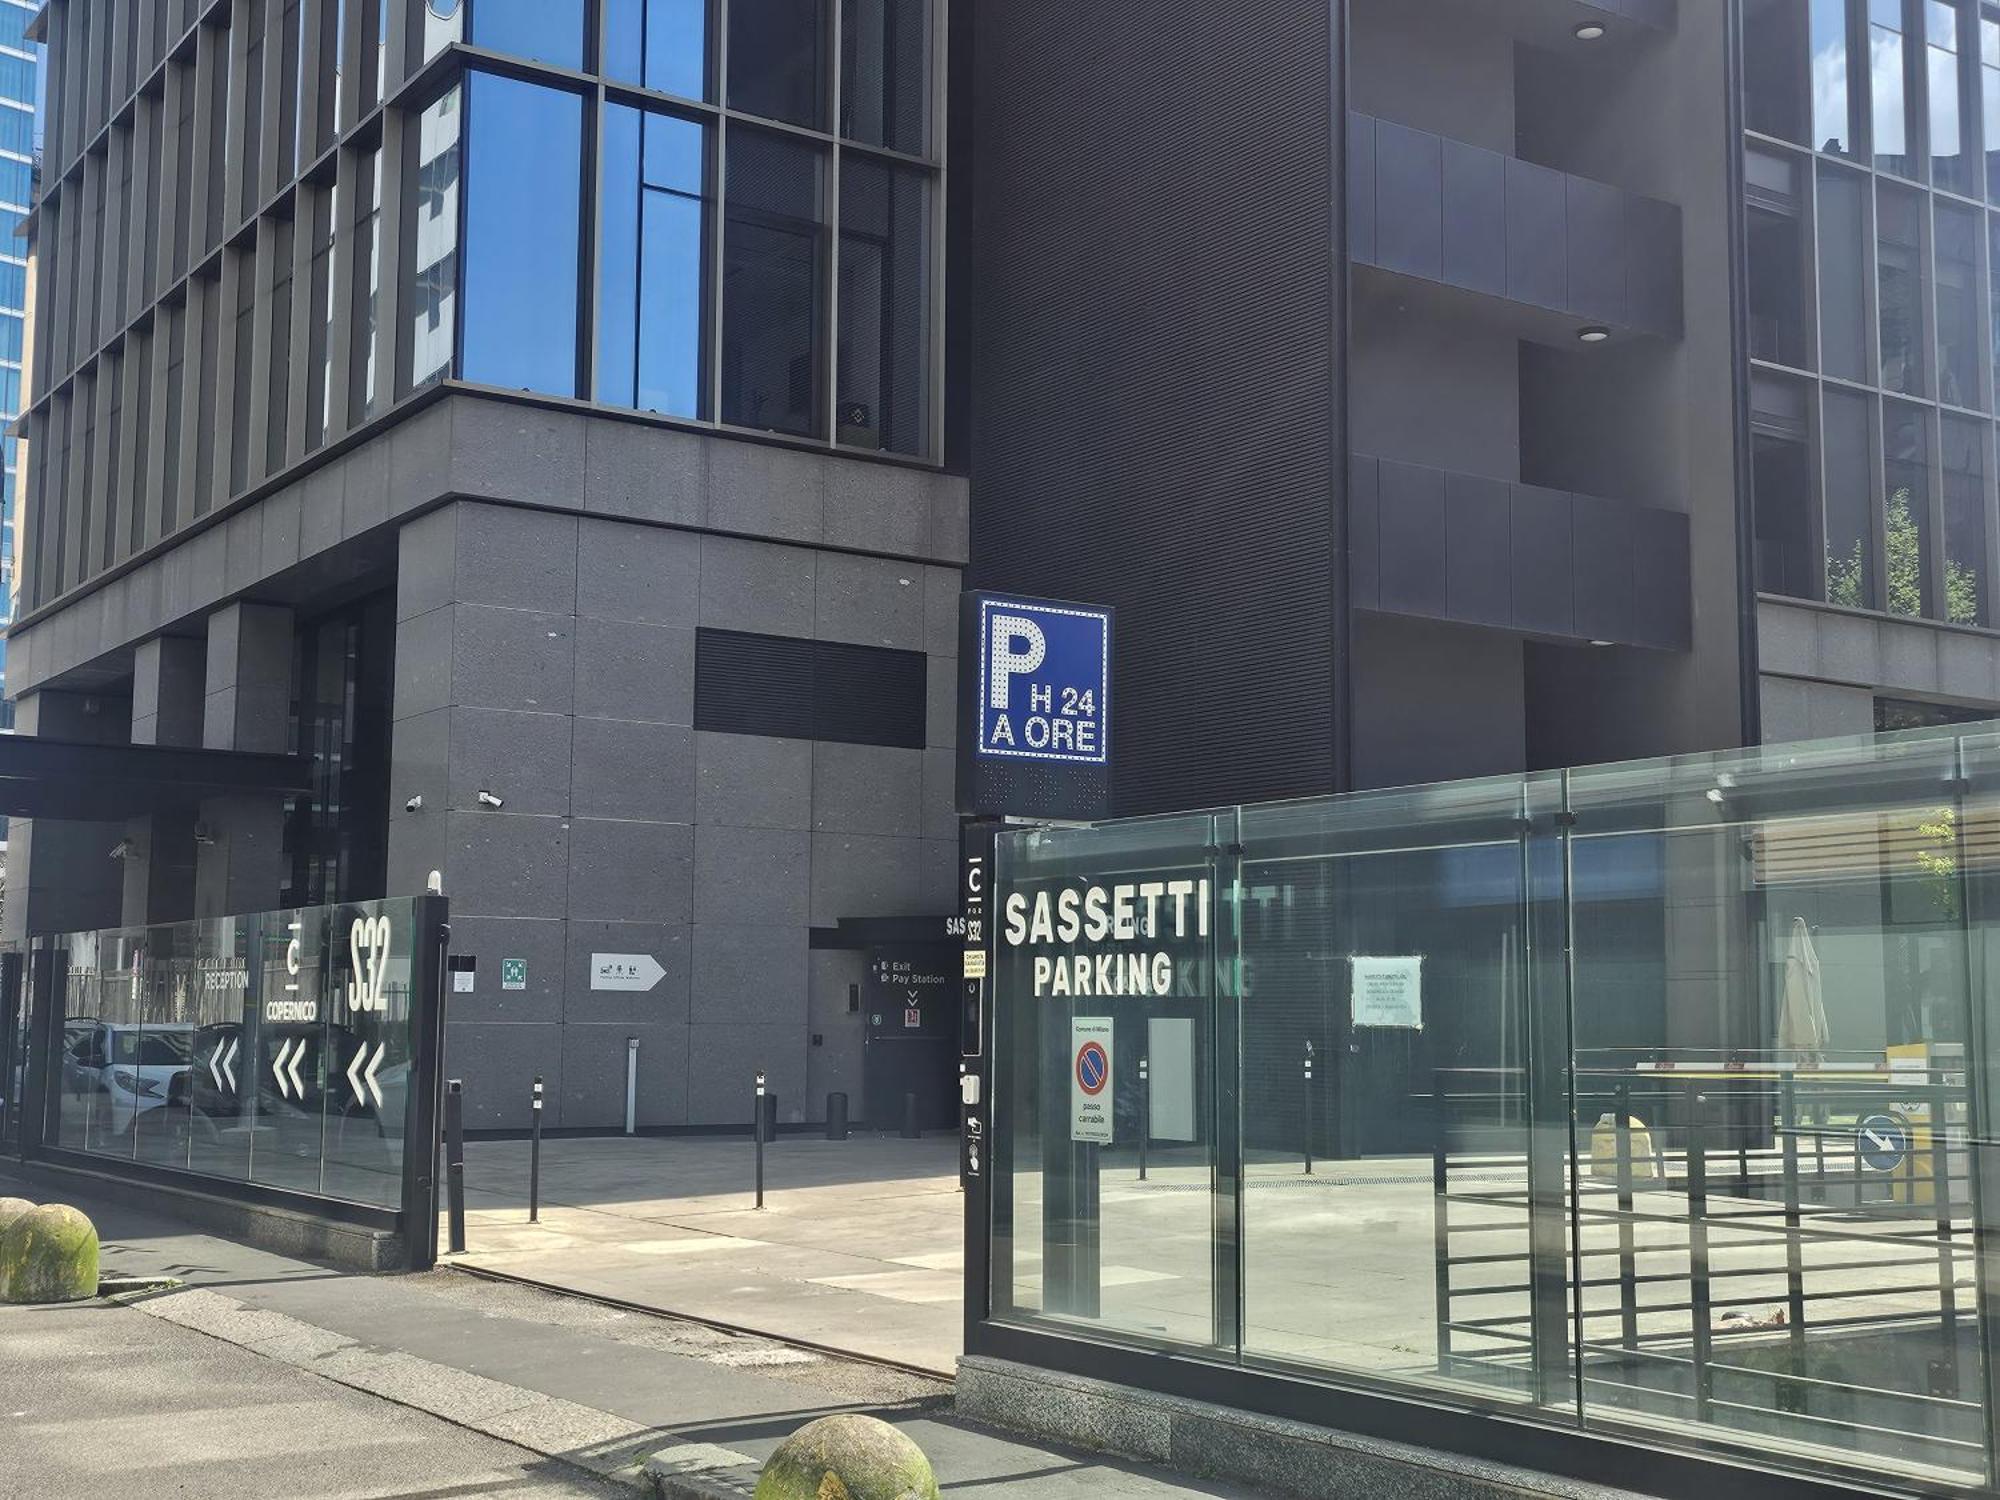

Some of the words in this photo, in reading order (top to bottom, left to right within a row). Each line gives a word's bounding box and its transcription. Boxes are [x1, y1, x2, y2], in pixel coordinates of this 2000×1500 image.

[991, 614, 1046, 709] P
[1030, 684, 1051, 713] H
[1061, 687, 1096, 716] 24
[991, 713, 1015, 746] A
[1024, 716, 1096, 751] ORE
[1005, 879, 1208, 946] SASSETTI
[967, 920, 982, 941] S32
[205, 970, 249, 990] RECEPTION
[349, 916, 391, 1012] S32
[892, 962, 911, 971] Exit
[892, 974, 910, 984] Pay
[912, 974, 945, 984] Station
[1033, 951, 1172, 997] PARKING
[267, 1001, 317, 1021] COPERNICO
